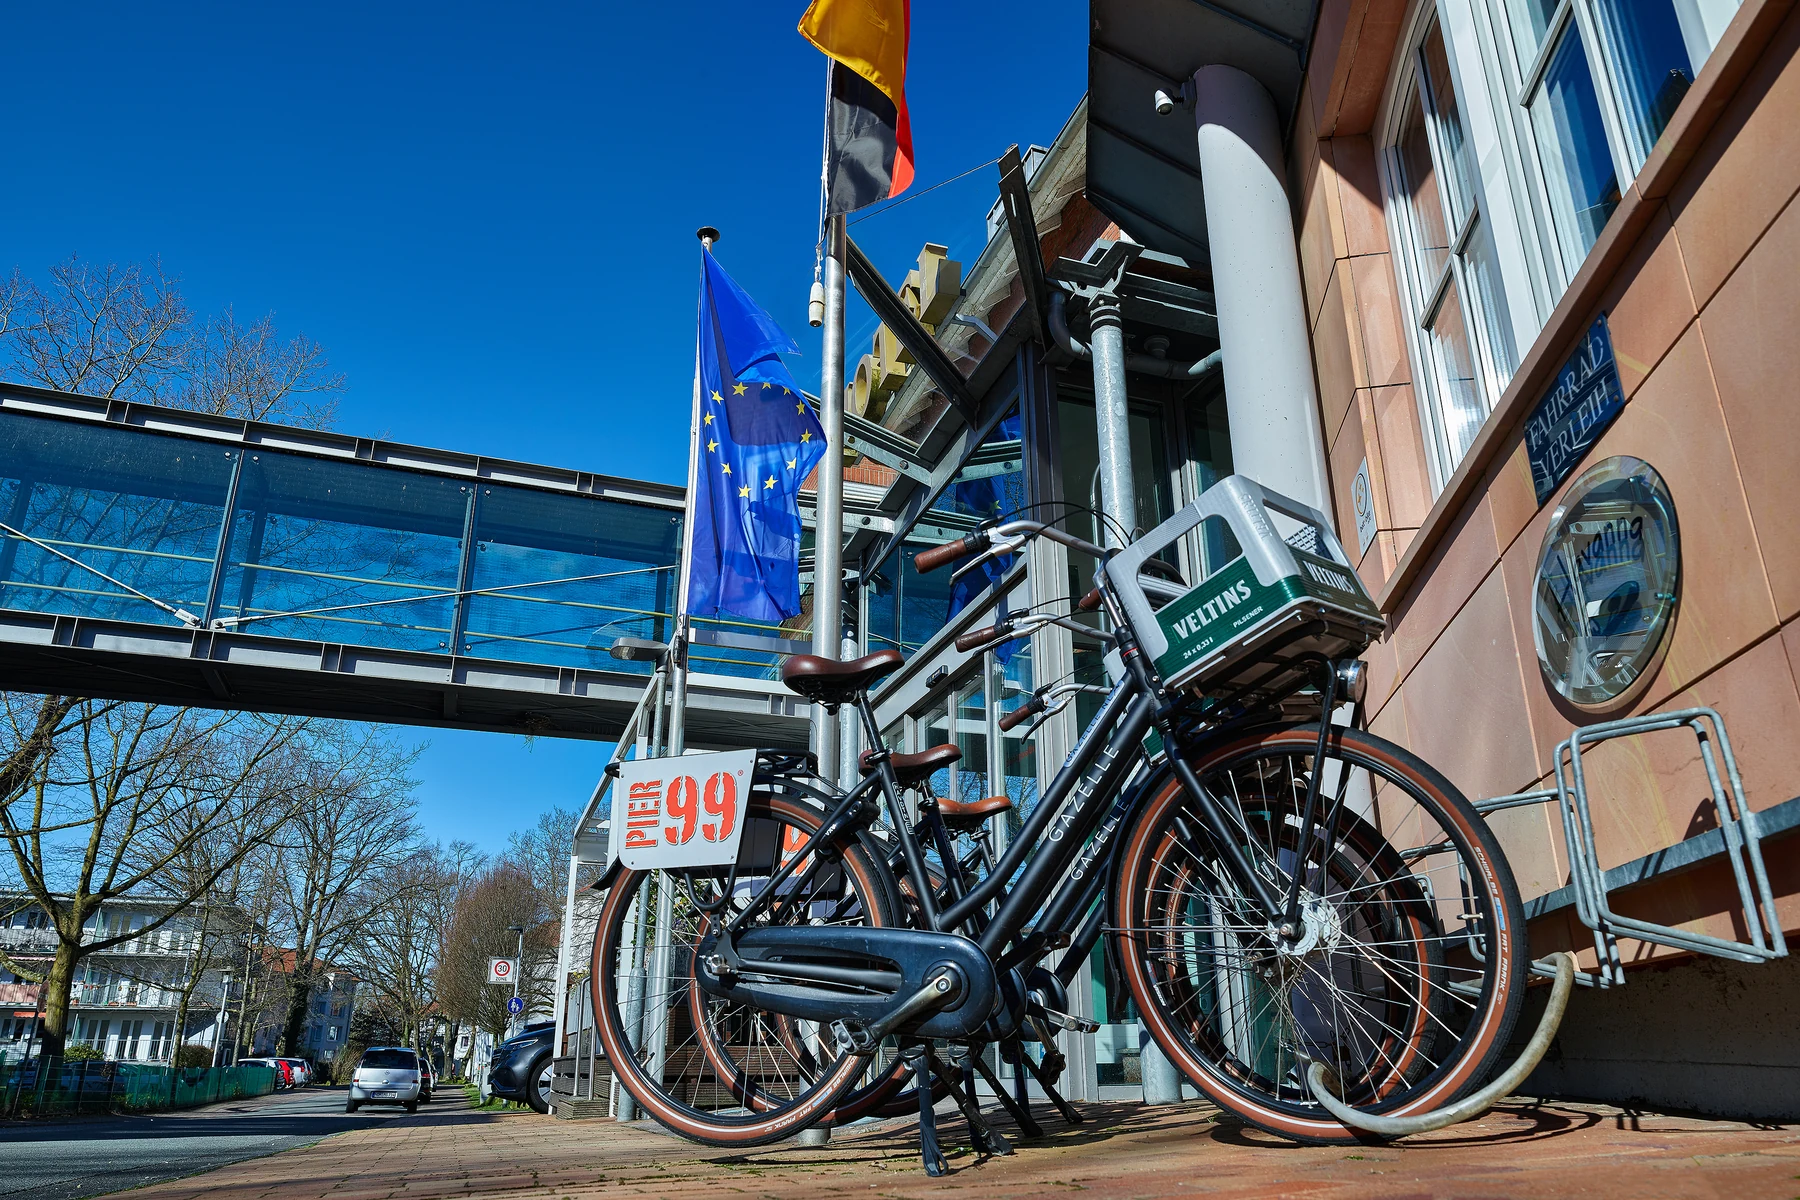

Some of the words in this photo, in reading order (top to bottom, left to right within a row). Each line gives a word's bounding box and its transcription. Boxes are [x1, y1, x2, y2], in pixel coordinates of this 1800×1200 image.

[1529, 336, 1604, 452] FAHRRAD
[1539, 377, 1611, 477] VERLEIH
[1302, 560, 1356, 595] VELTINS
[1172, 579, 1251, 639] VELTINS
[1232, 605, 1263, 628] PILSENER
[1183, 649, 1192, 659] 24
[1196, 639, 1210, 650] 0,33
[1066, 714, 1101, 762] GAZELLE
[625, 779, 663, 849] PIER
[664, 771, 738, 846] 99
[1048, 744, 1120, 843] GAZELLE
[1070, 800, 1130, 881] GAZELLE
[1474, 846, 1498, 895] SCHWALBE
[1499, 958, 1508, 991] FRANK
[774, 1116, 796, 1130] FRANK
[799, 1106, 812, 1117] FAT
